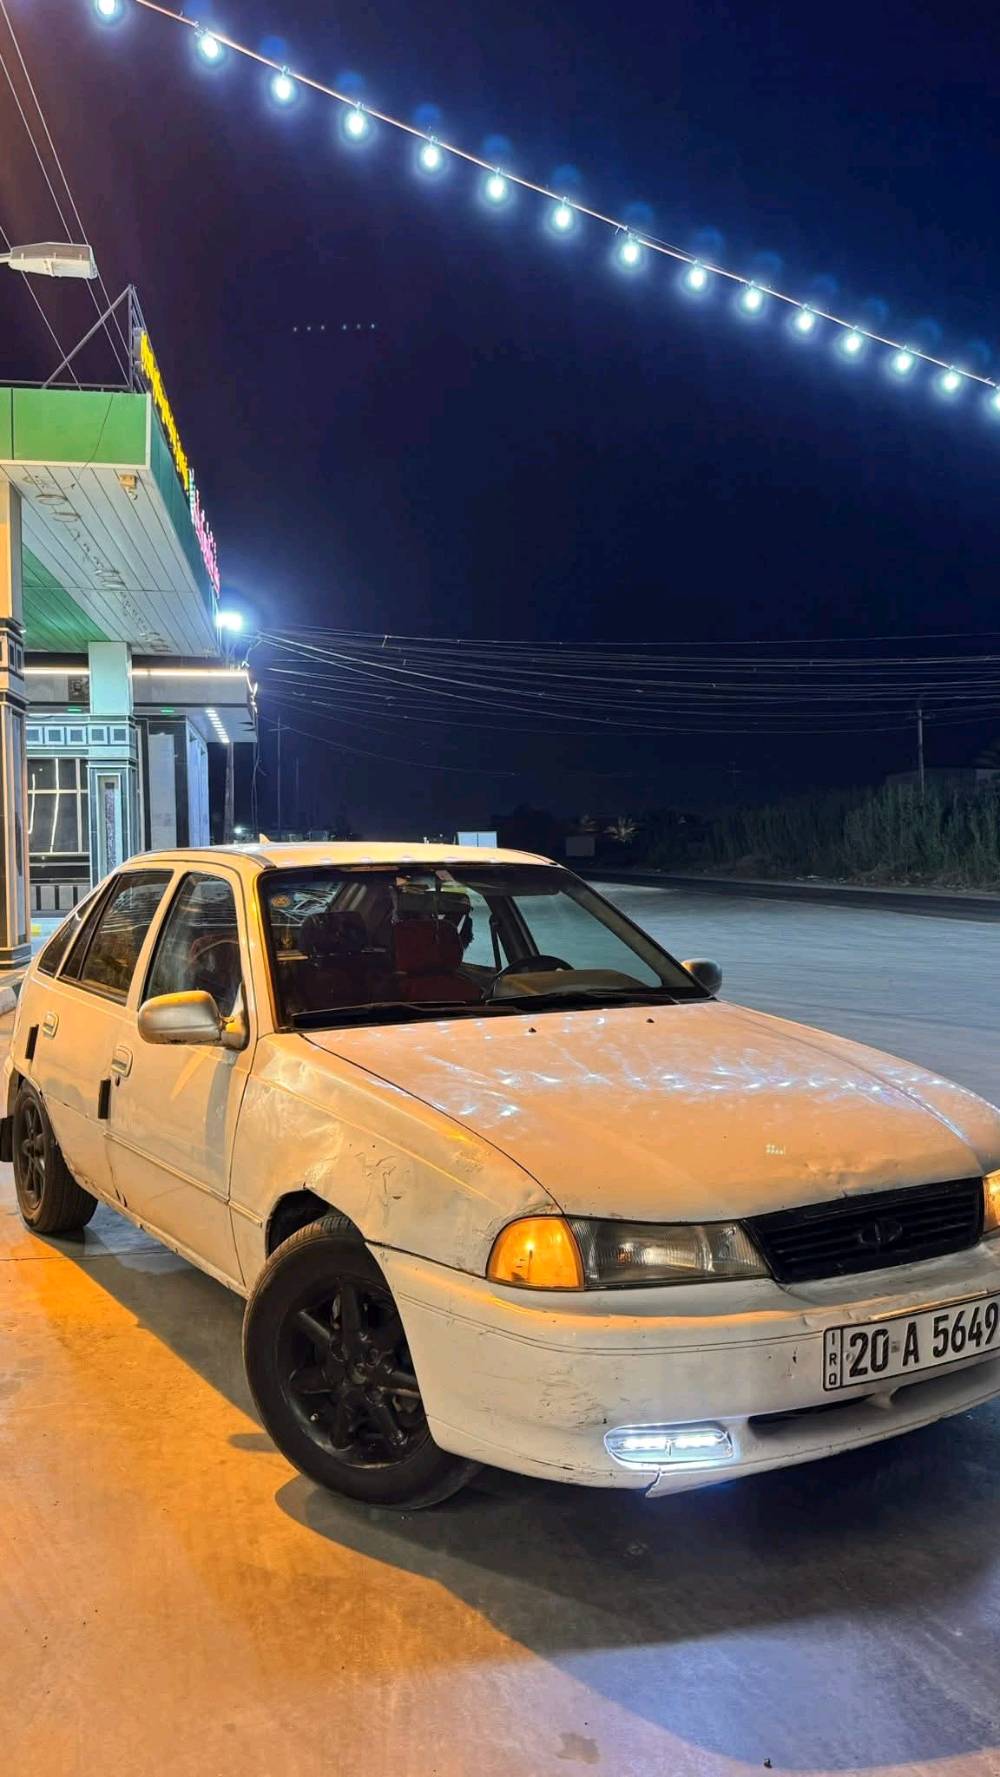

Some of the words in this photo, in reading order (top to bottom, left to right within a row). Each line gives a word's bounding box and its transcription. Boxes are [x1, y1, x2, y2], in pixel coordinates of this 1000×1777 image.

[829, 1332, 837, 1386] IRQ
[849, 1328, 889, 1378] 20
[902, 1321, 919, 1366] A
[933, 1302, 999, 1358] 5649
